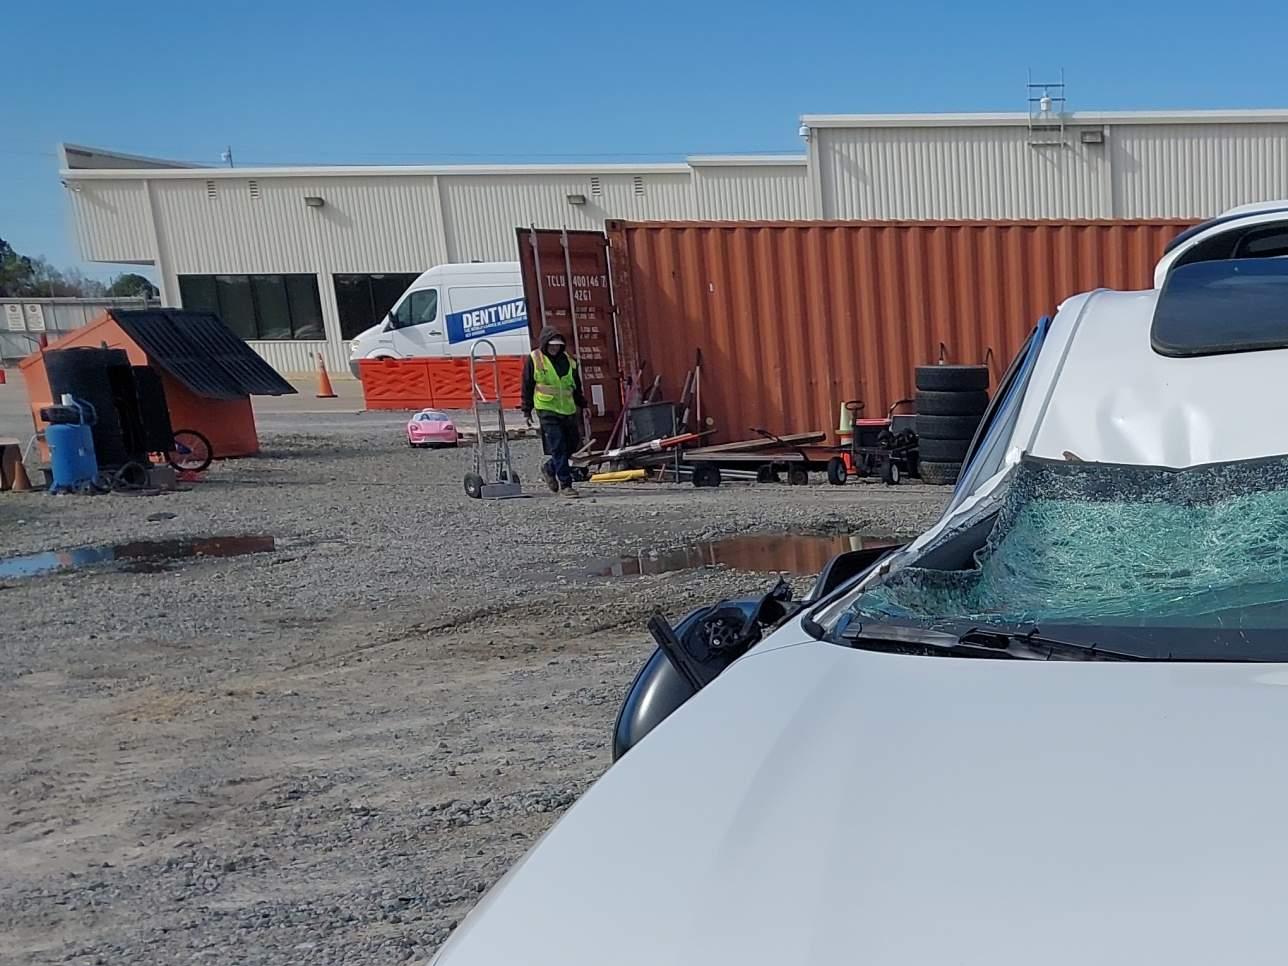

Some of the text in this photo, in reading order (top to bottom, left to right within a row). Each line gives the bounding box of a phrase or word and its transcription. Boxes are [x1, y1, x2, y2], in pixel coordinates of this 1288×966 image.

[546, 275, 565, 287] TCLU
[574, 290, 592, 301] 42G1
[462, 306, 497, 329] DENT
